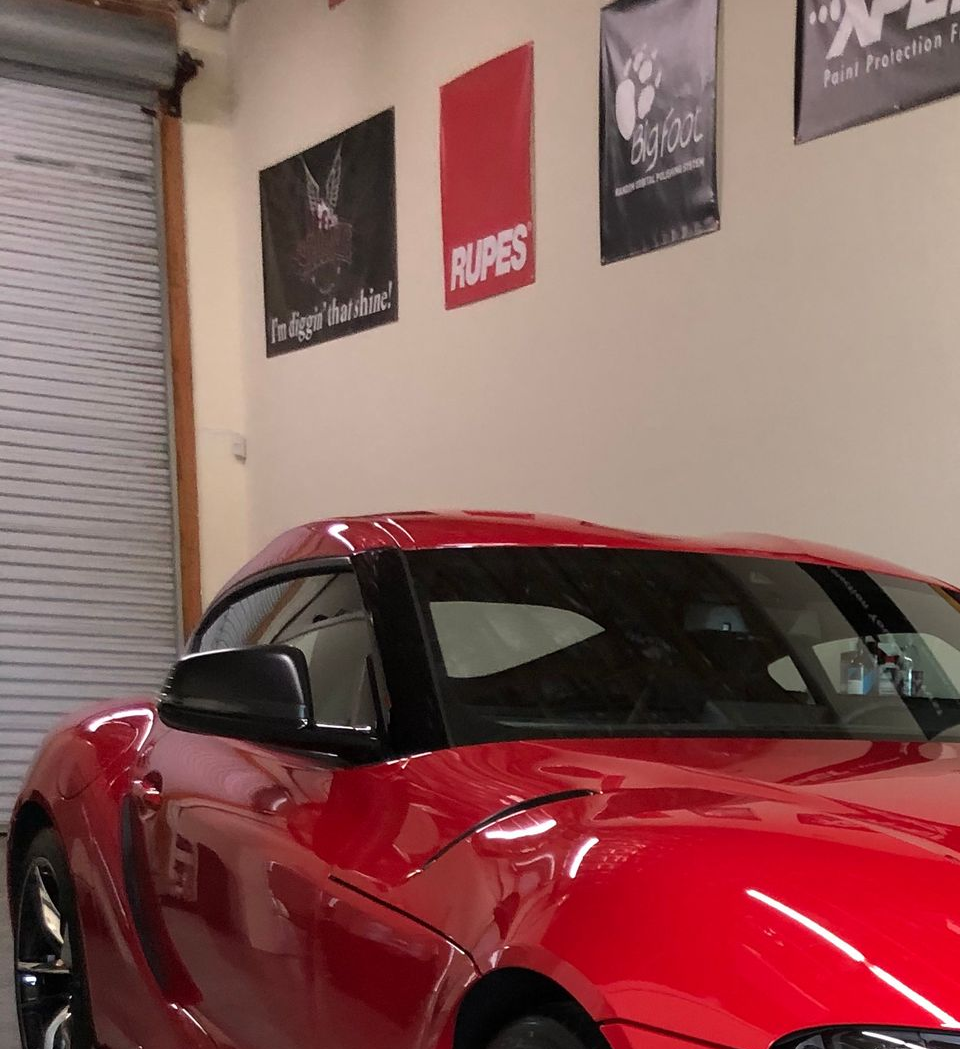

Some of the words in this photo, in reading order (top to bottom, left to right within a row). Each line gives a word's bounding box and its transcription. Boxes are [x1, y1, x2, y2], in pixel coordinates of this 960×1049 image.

[823, 61, 859, 88] Paint
[865, 34, 942, 73] Protection
[450, 223, 528, 292] RUPES
[271, 317, 287, 344] I'm
[327, 298, 353, 326] that
[353, 281, 393, 319] shine!
